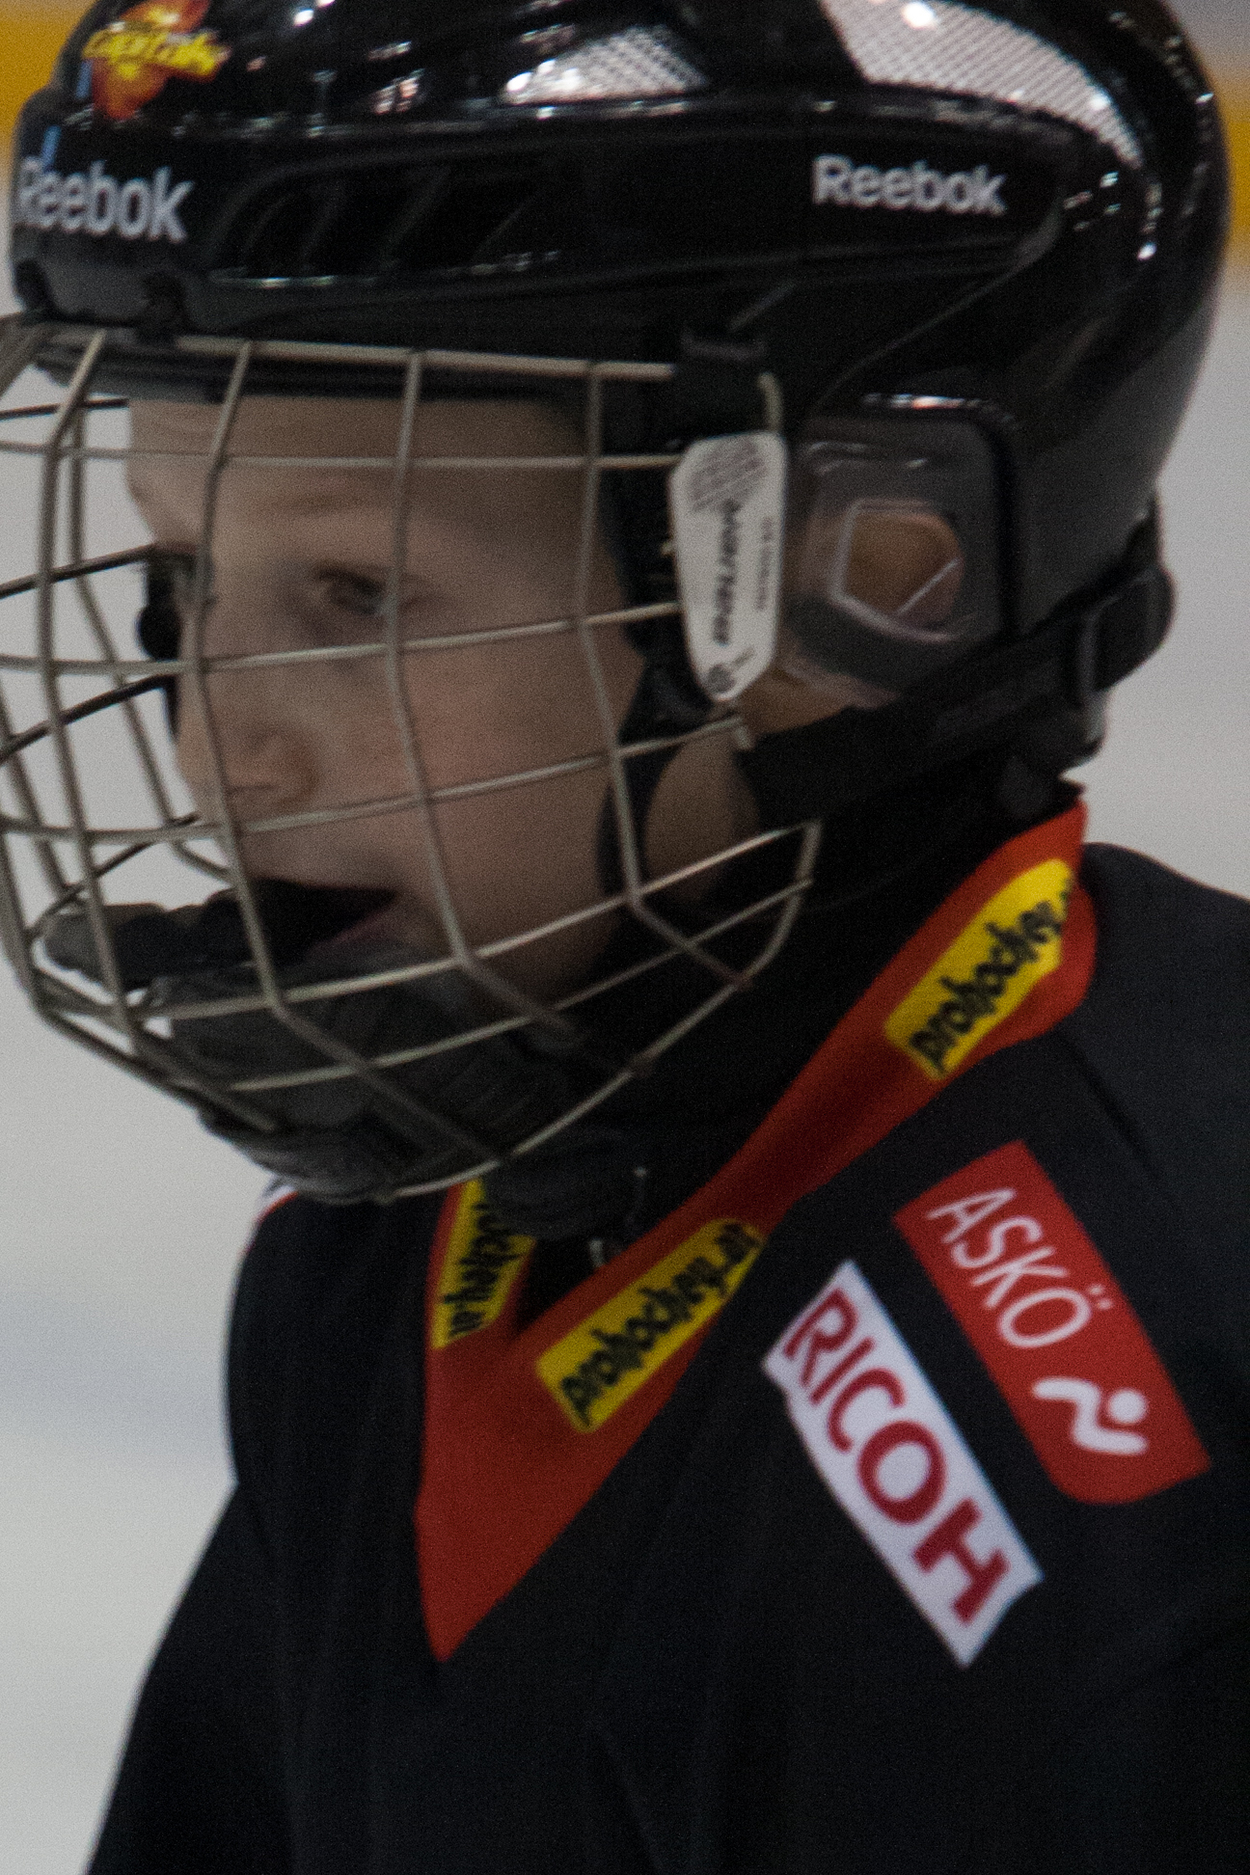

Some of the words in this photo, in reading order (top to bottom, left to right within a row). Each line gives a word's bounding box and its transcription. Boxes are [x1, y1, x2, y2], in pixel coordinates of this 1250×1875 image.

[14, 156, 195, 243] Reebok
[812, 154, 1006, 216] Reebok
[925, 1186, 1114, 1350] ASKÖ
[781, 1287, 1011, 1625] RICOH
